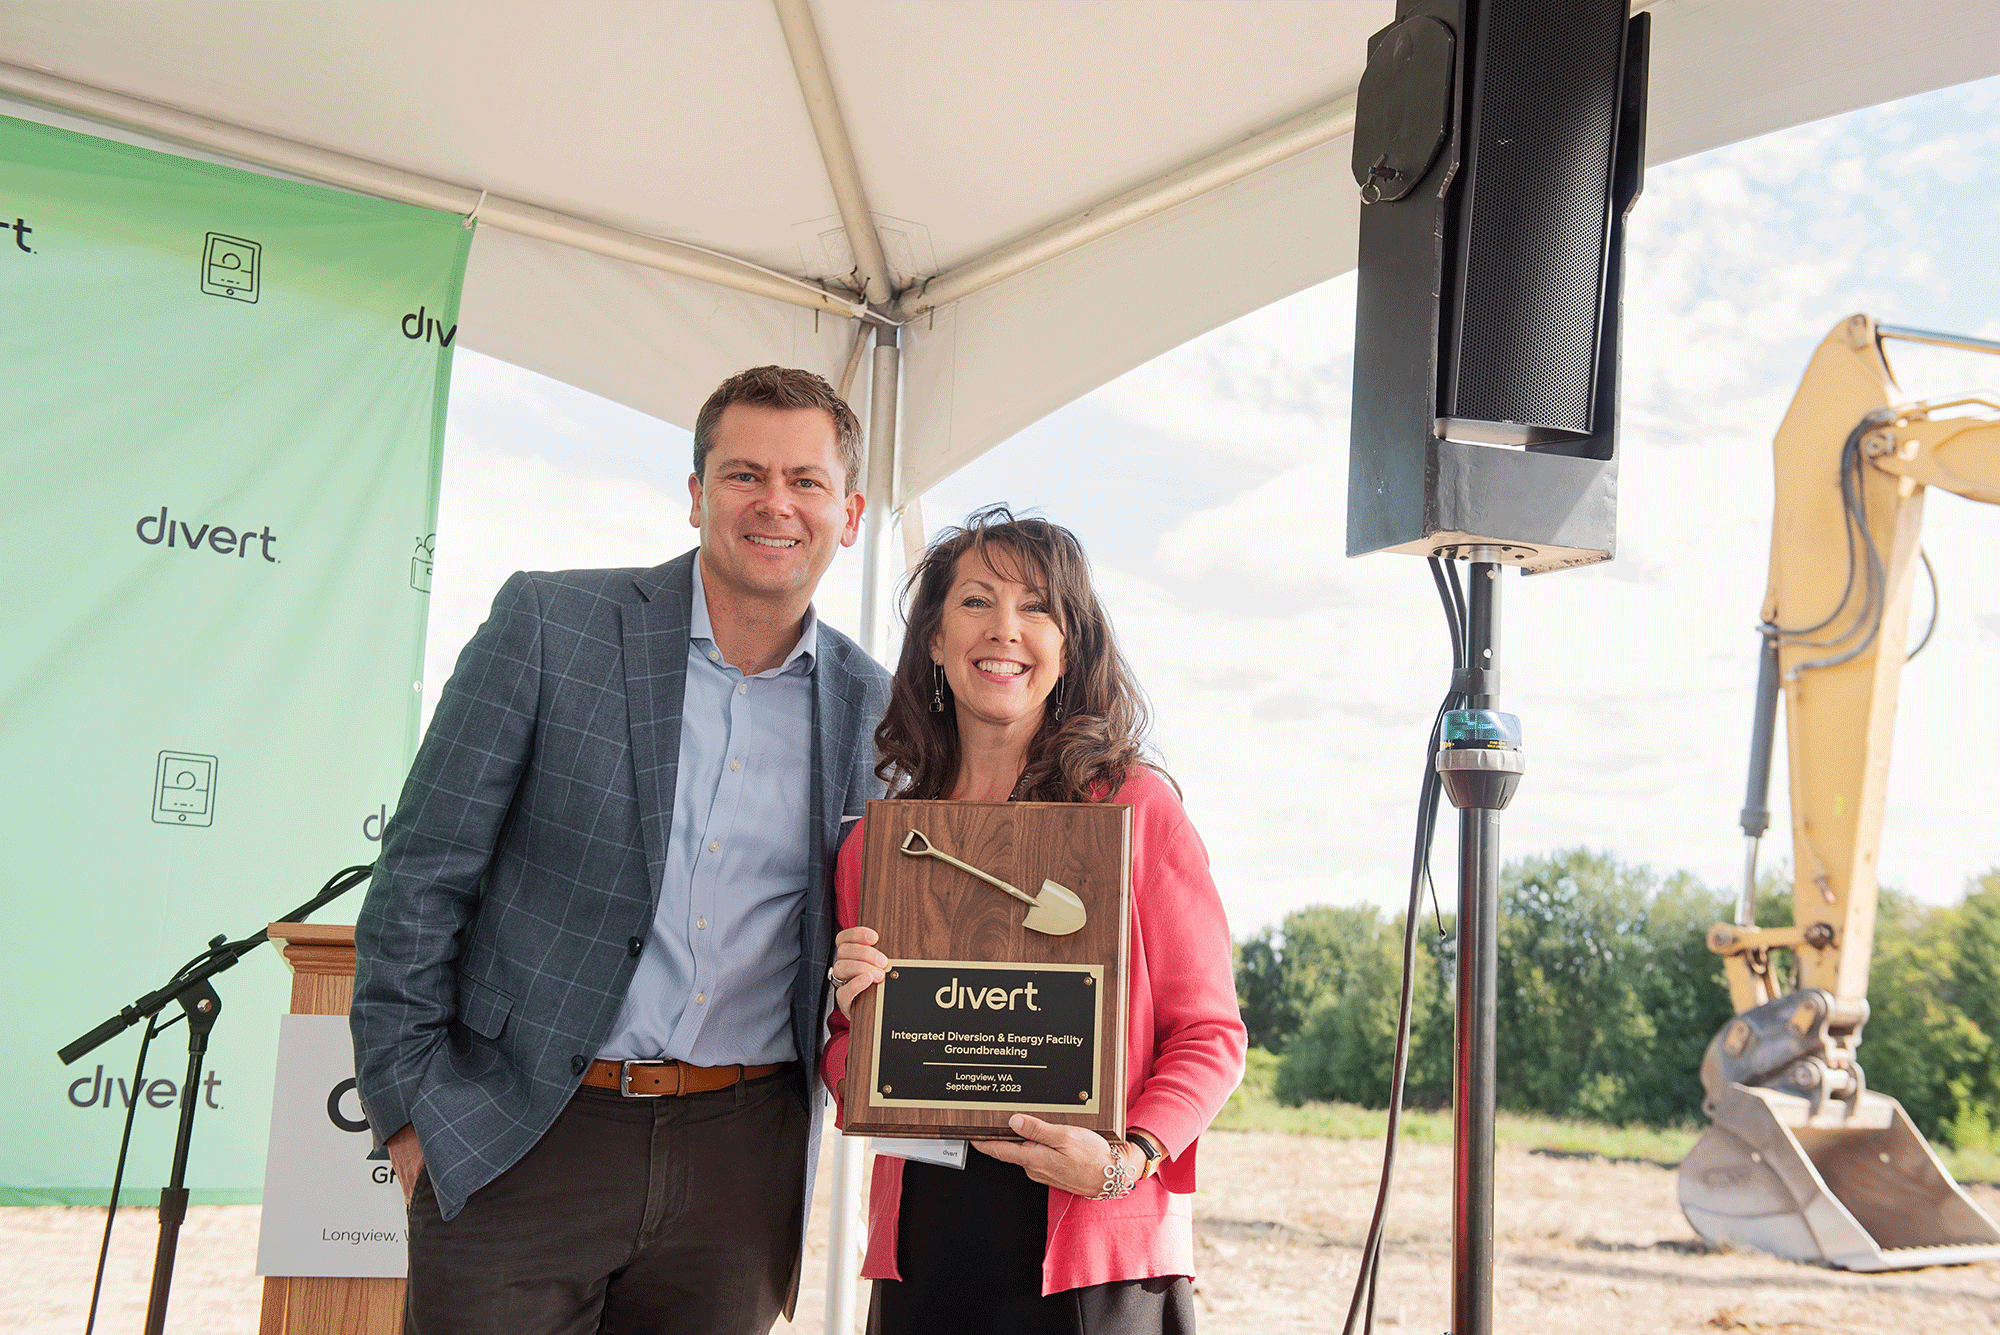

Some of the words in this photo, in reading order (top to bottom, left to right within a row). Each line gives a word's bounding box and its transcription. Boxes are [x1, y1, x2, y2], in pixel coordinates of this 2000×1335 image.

[891, 1030, 945, 1042] Integrated
[947, 1032, 995, 1043] Diversion
[997, 1033, 1005, 1043] &
[1007, 1034, 1044, 1046] Energy
[1046, 1035, 1084, 1047] Facility
[944, 1045, 1028, 1058] Groundbreaking
[955, 1073, 996, 1083] Longview,
[997, 1074, 1013, 1082] WA
[946, 1083, 990, 1093] September
[992, 1083, 999, 1093] 7,
[1000, 1084, 1022, 1092] 2023
[322, 1228, 399, 1245] Longview,
